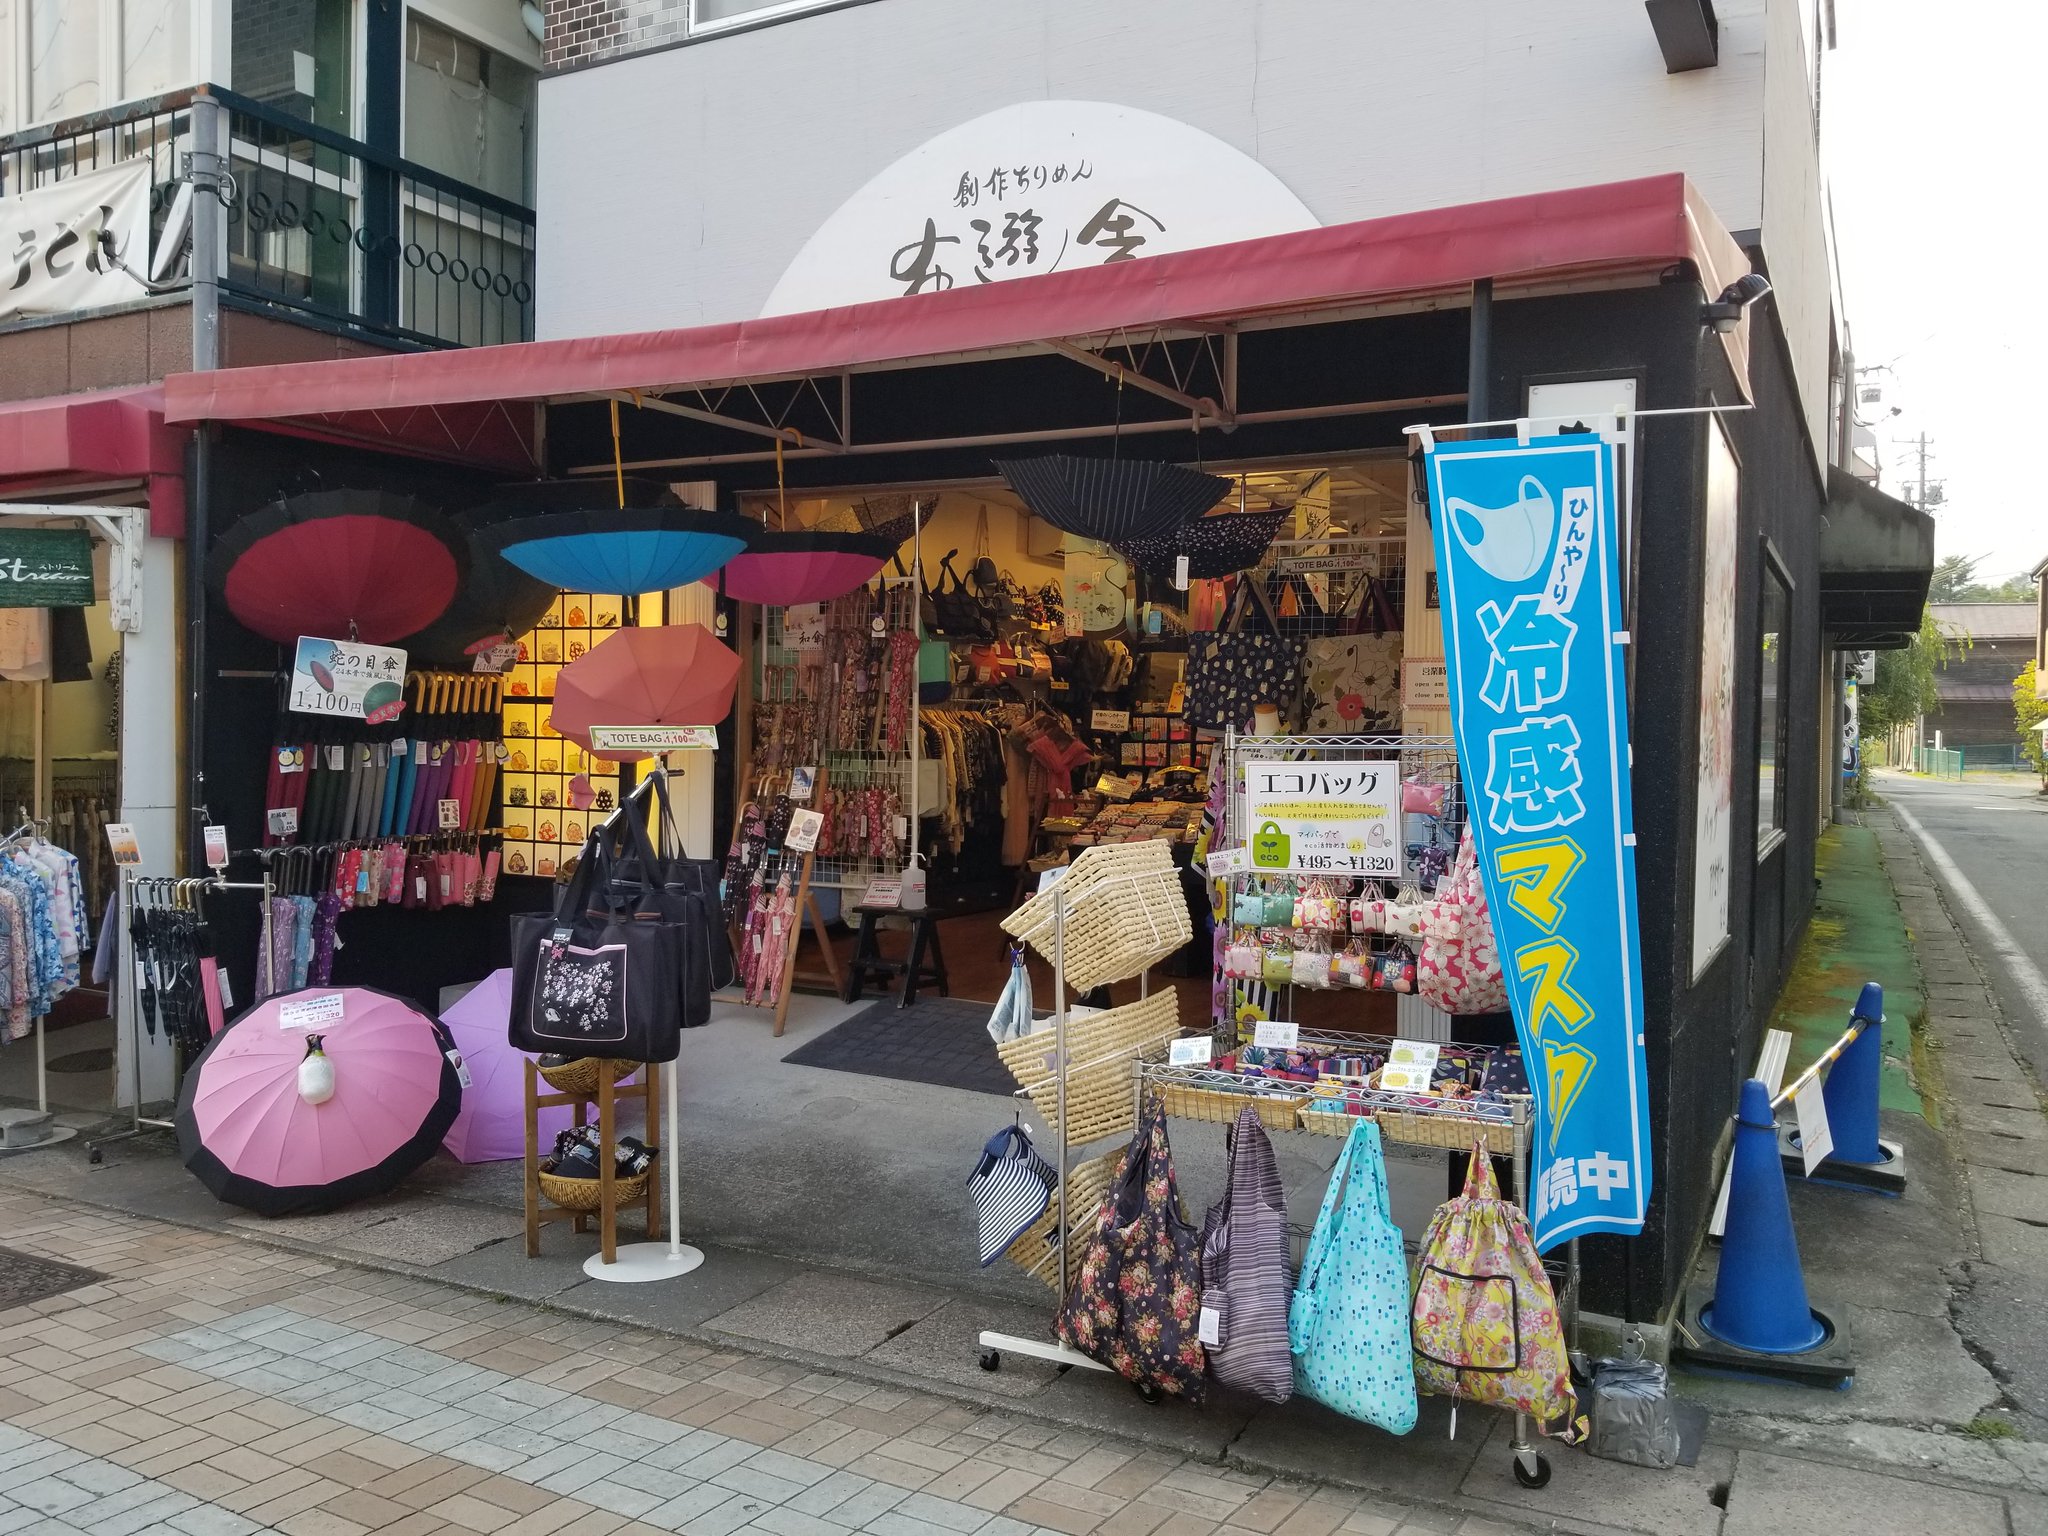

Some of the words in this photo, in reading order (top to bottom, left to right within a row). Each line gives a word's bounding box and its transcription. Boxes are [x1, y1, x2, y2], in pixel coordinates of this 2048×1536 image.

[953, 159, 1093, 208] 創作ちりめん
[39, 563, 79, 571] ストリーム
[1293, 561, 1314, 569] TOTE
[1316, 560, 1334, 568] BAG
[329, 649, 399, 673] 蛇の目傘
[296, 690, 362, 713] 1,100円
[610, 733, 637, 743] TOTE
[640, 733, 662, 743] BAG
[1259, 771, 1379, 796] エコバッグ
[1260, 854, 1279, 862] eco
